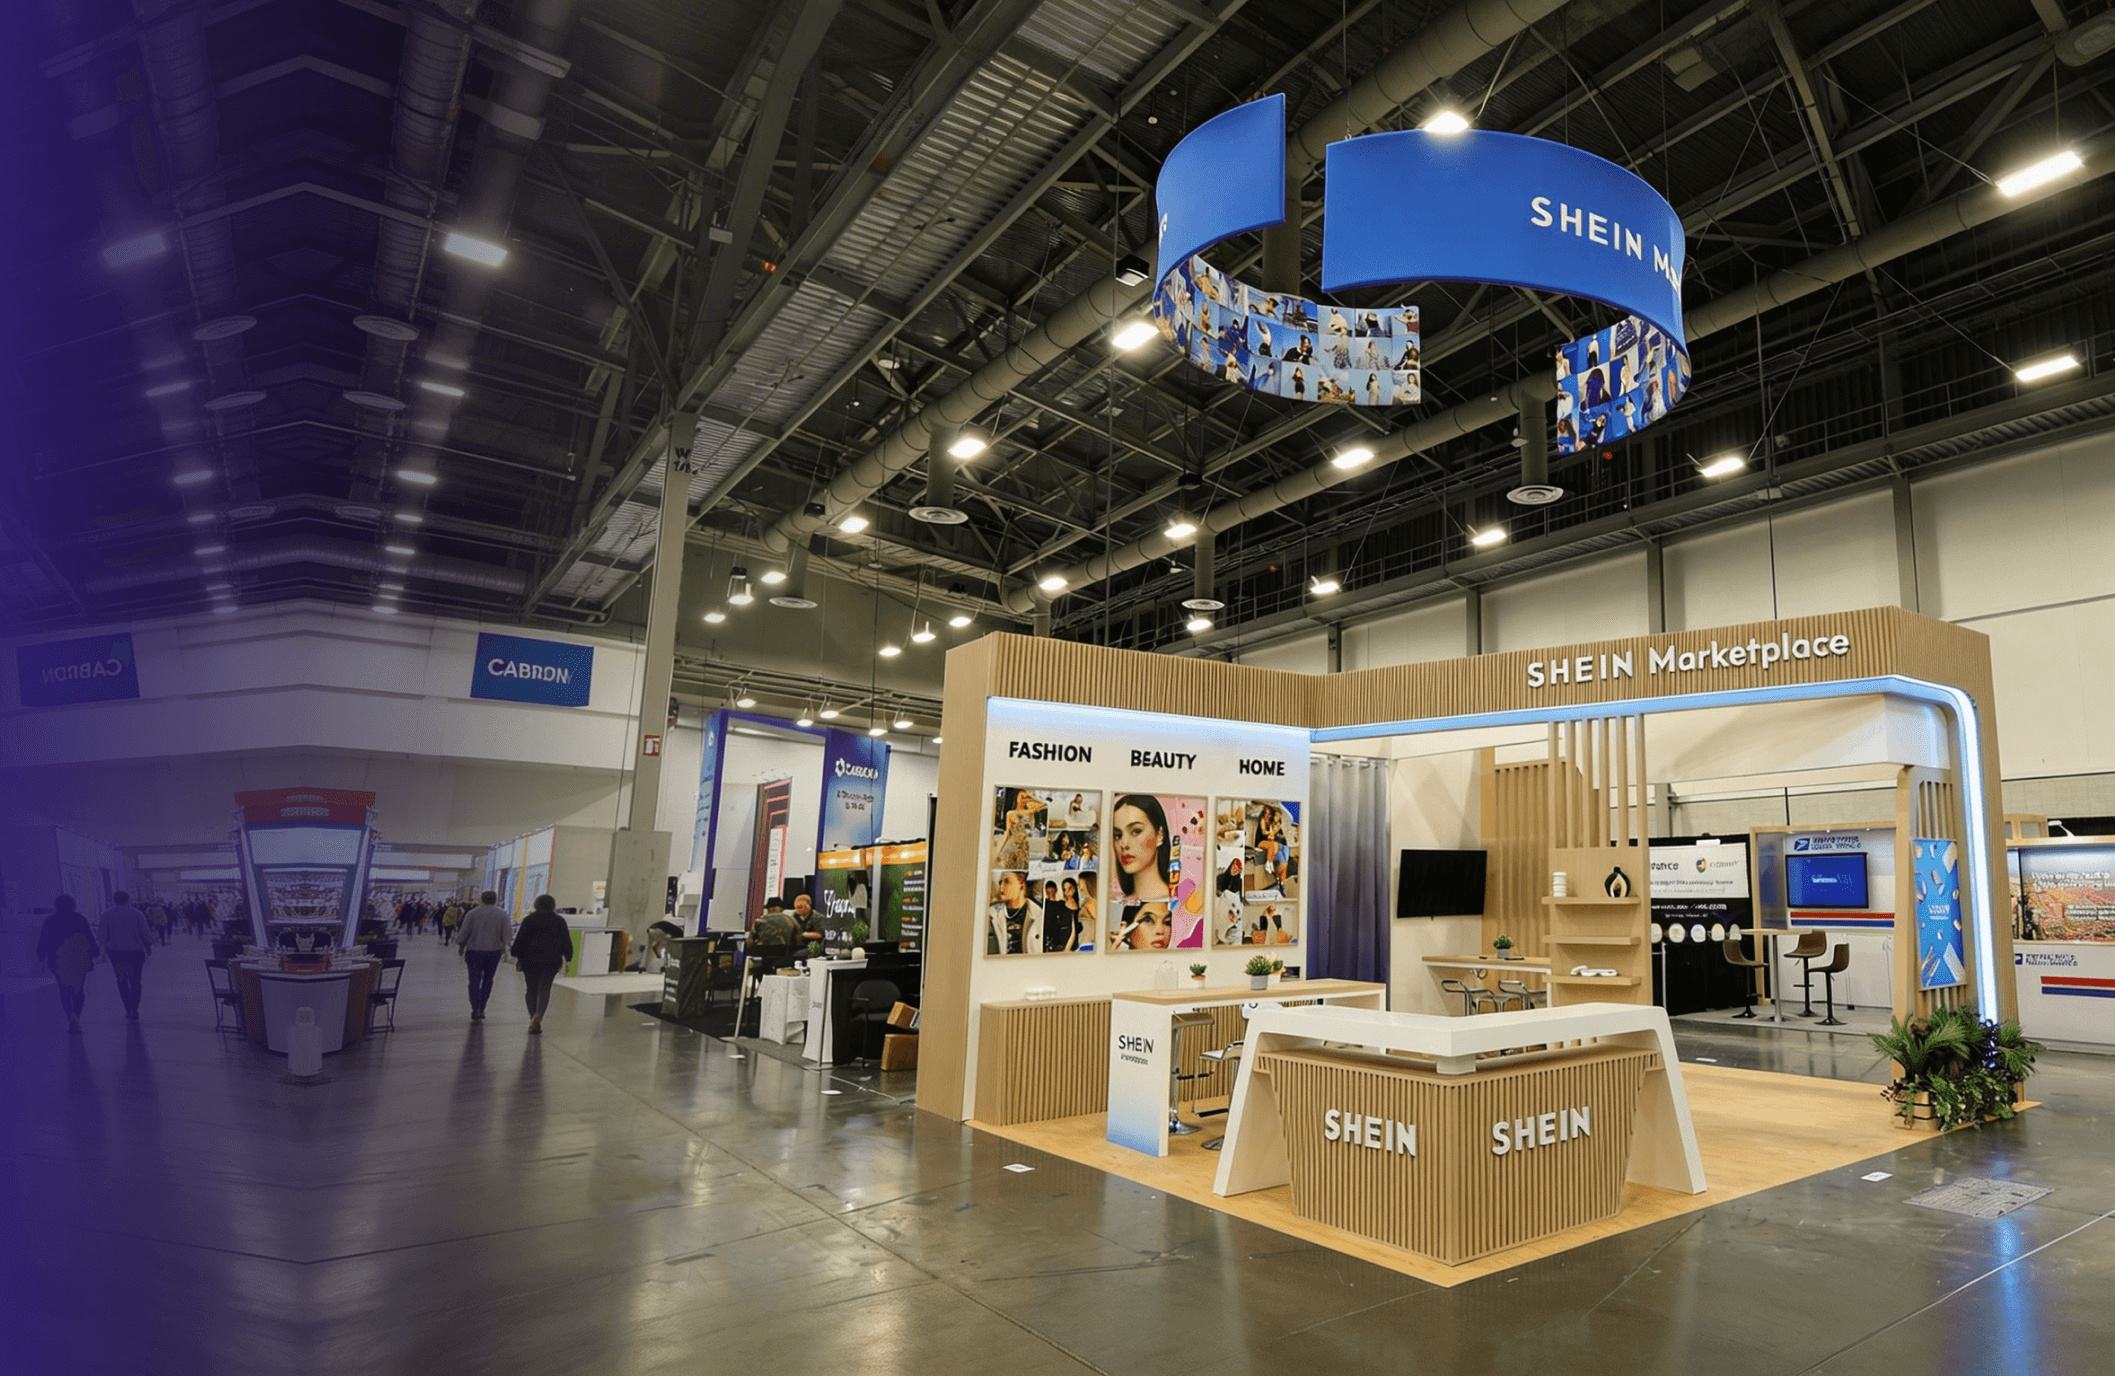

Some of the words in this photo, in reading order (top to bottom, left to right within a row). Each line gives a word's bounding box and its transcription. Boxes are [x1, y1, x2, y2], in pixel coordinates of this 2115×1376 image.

[1530, 195, 1643, 262] SHEIN
[1527, 651, 1634, 688] SHEIN
[1649, 631, 1850, 675] Marketplace
[1009, 741, 1092, 763] FASHION
[1130, 749, 1197, 770] BEAUTY
[1239, 758, 1286, 776] HOME
[1118, 1034, 1154, 1054] SHEIN
[1324, 1108, 1418, 1158] SHEIN
[1491, 1105, 1592, 1156] SHEIN
